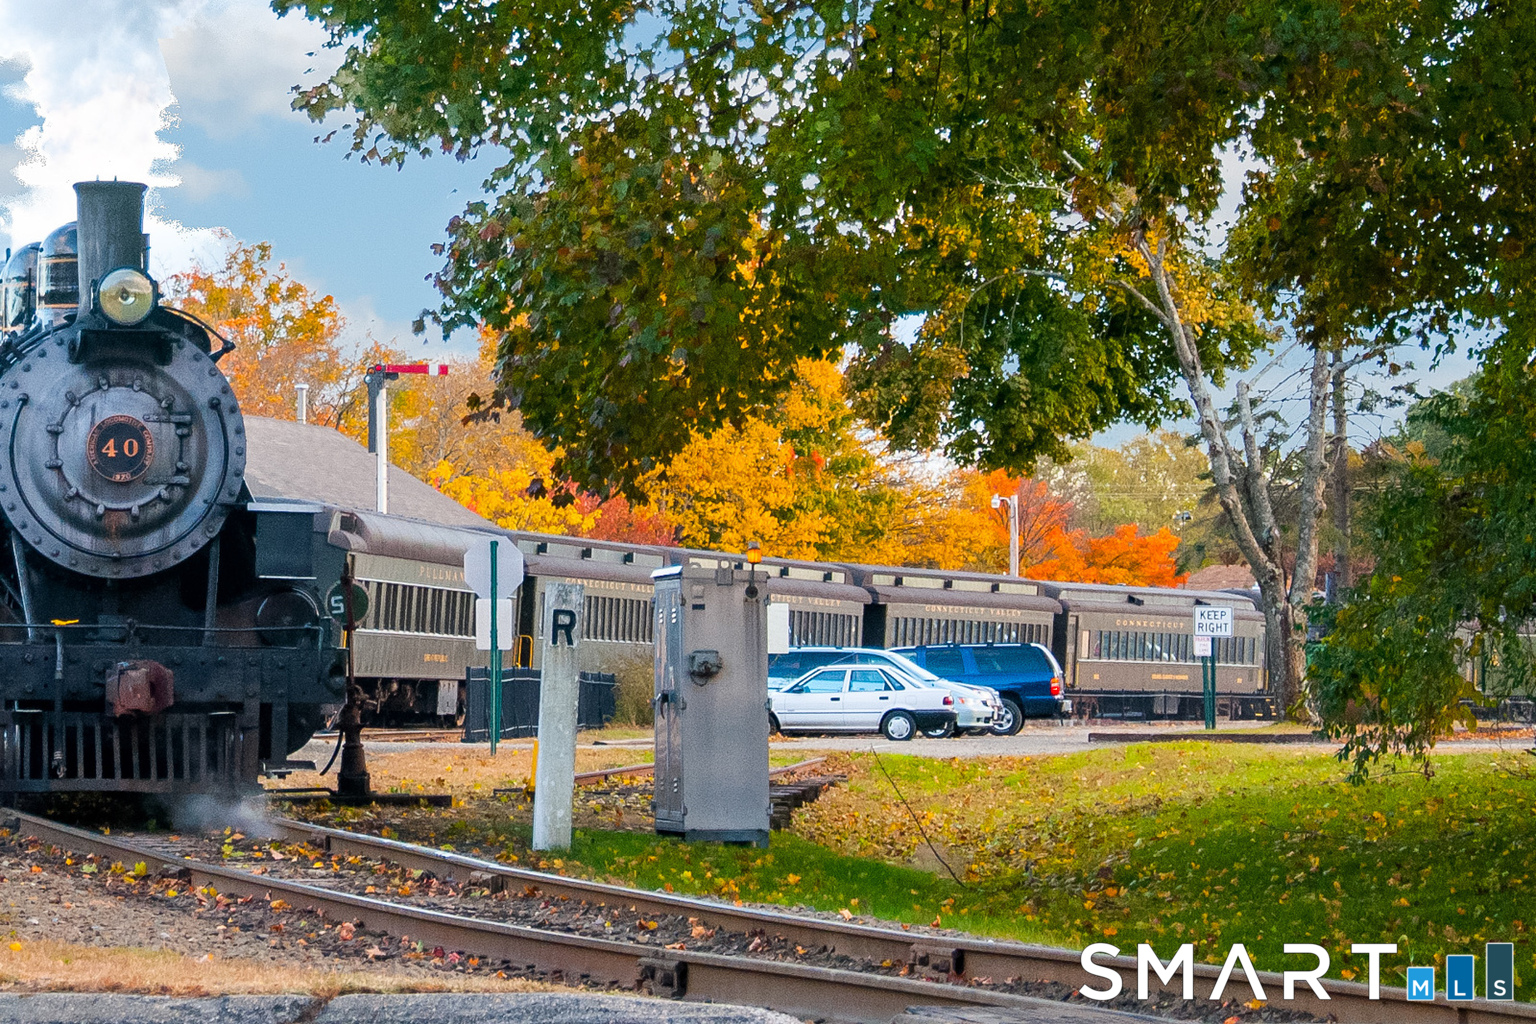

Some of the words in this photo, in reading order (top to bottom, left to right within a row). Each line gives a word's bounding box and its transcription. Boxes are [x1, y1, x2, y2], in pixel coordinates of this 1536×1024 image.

[101, 437, 139, 458] 40
[630, 583, 654, 594] VALL
[330, 595, 345, 614] S
[925, 605, 985, 615] CONNECTICUT
[990, 607, 1022, 617] VALLEY
[1200, 610, 1227, 621] KEEP
[551, 608, 577, 646] R
[1115, 619, 1185, 629] CONNECTICUT
[1197, 622, 1229, 633] RIGHT
